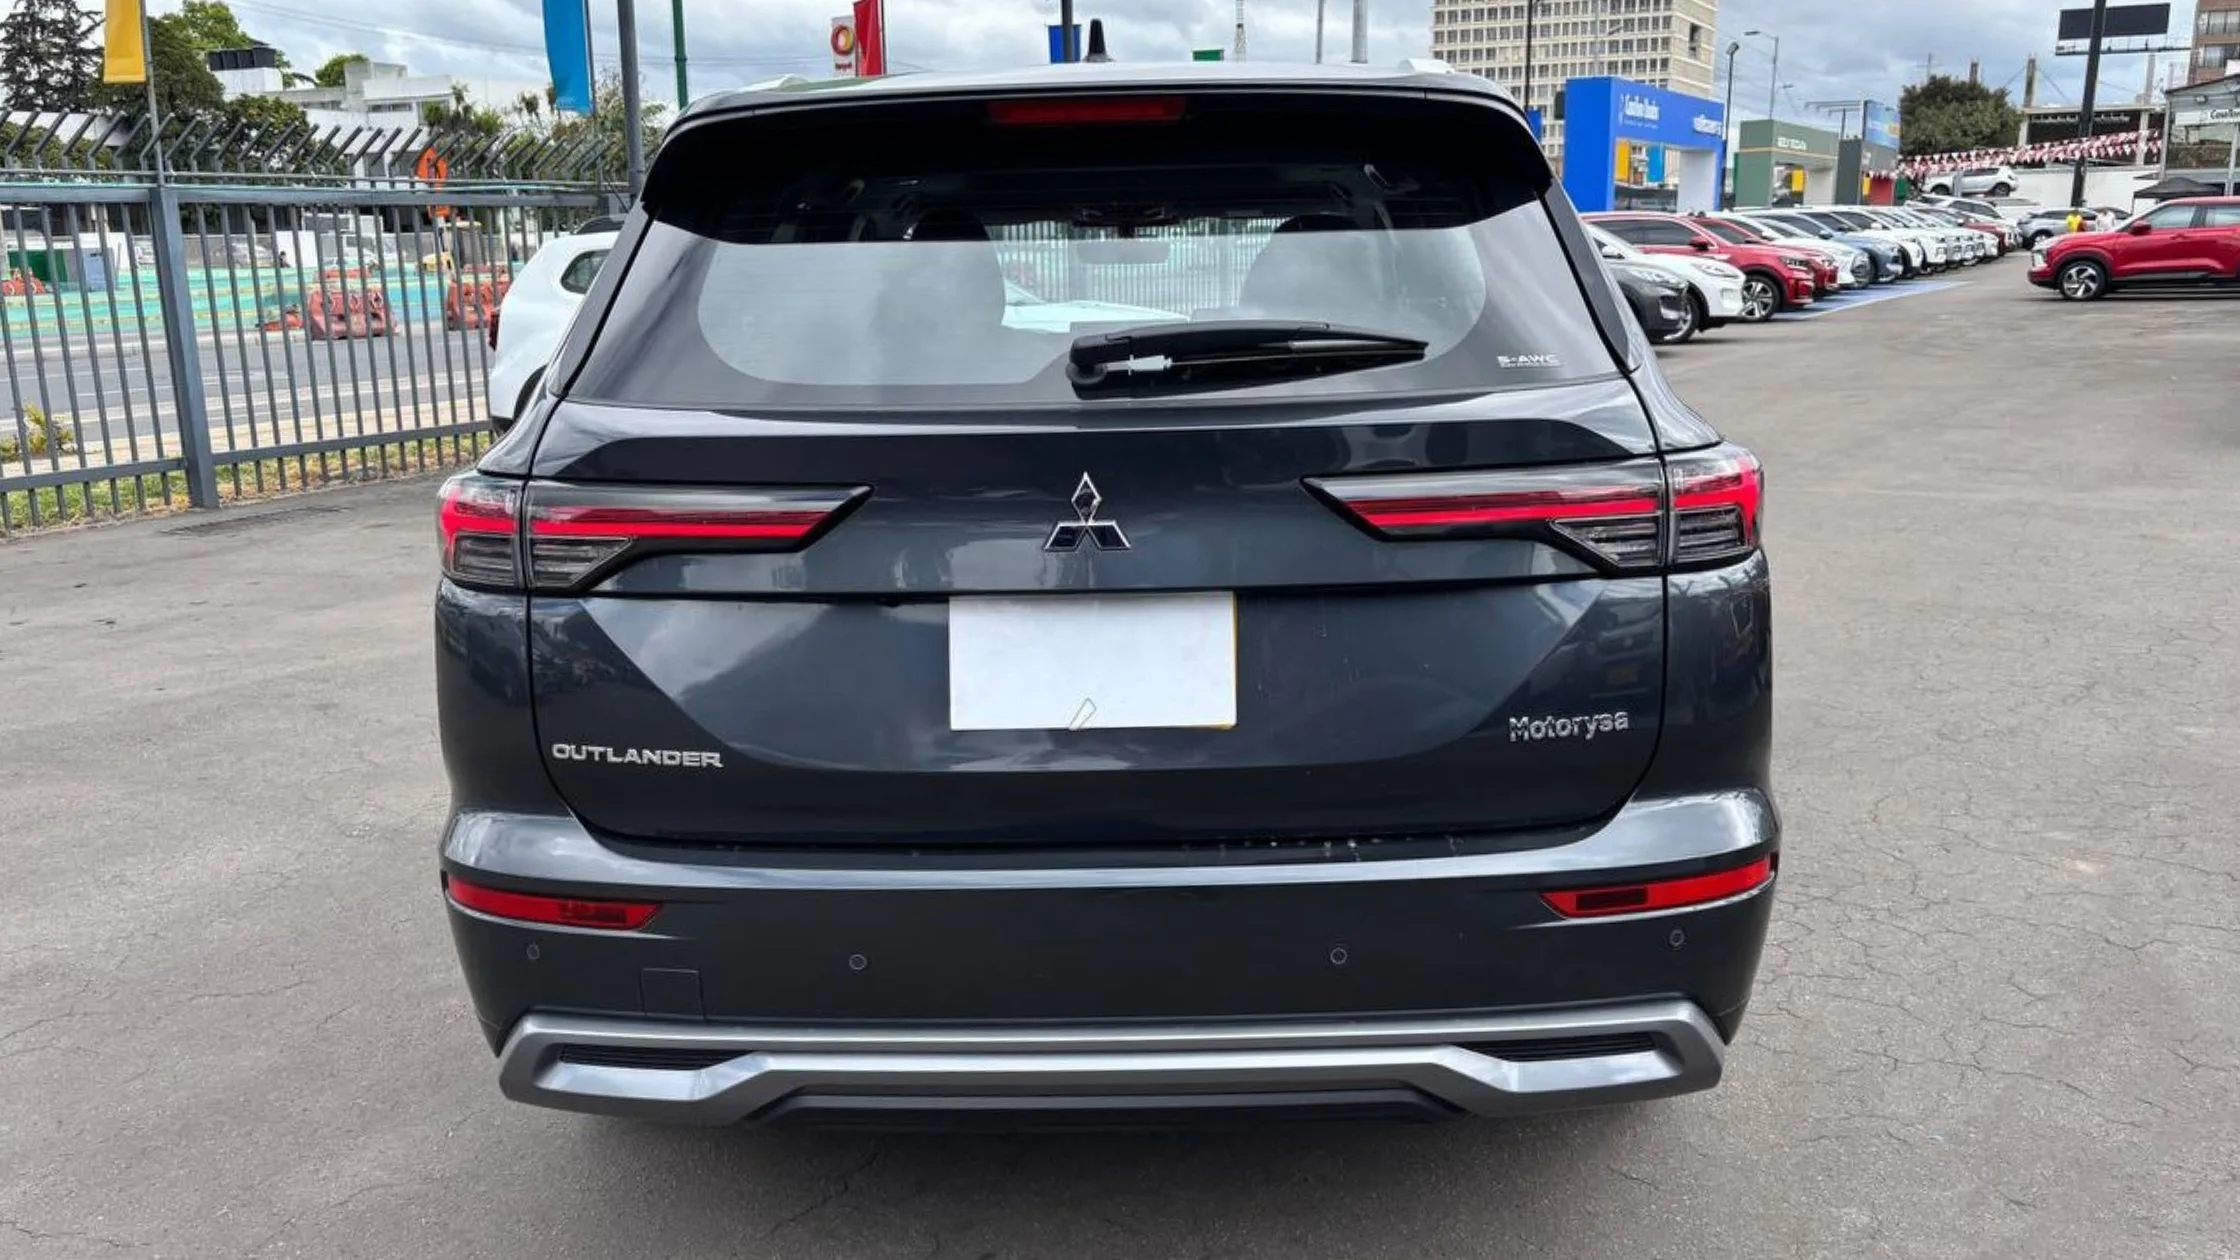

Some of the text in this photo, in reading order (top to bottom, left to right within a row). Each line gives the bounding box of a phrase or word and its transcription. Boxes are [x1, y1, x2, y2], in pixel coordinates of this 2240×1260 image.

[1497, 354, 1561, 368] S-AWC
[1509, 711, 1629, 741] Motorysa
[551, 743, 724, 768] OUTLANDER
